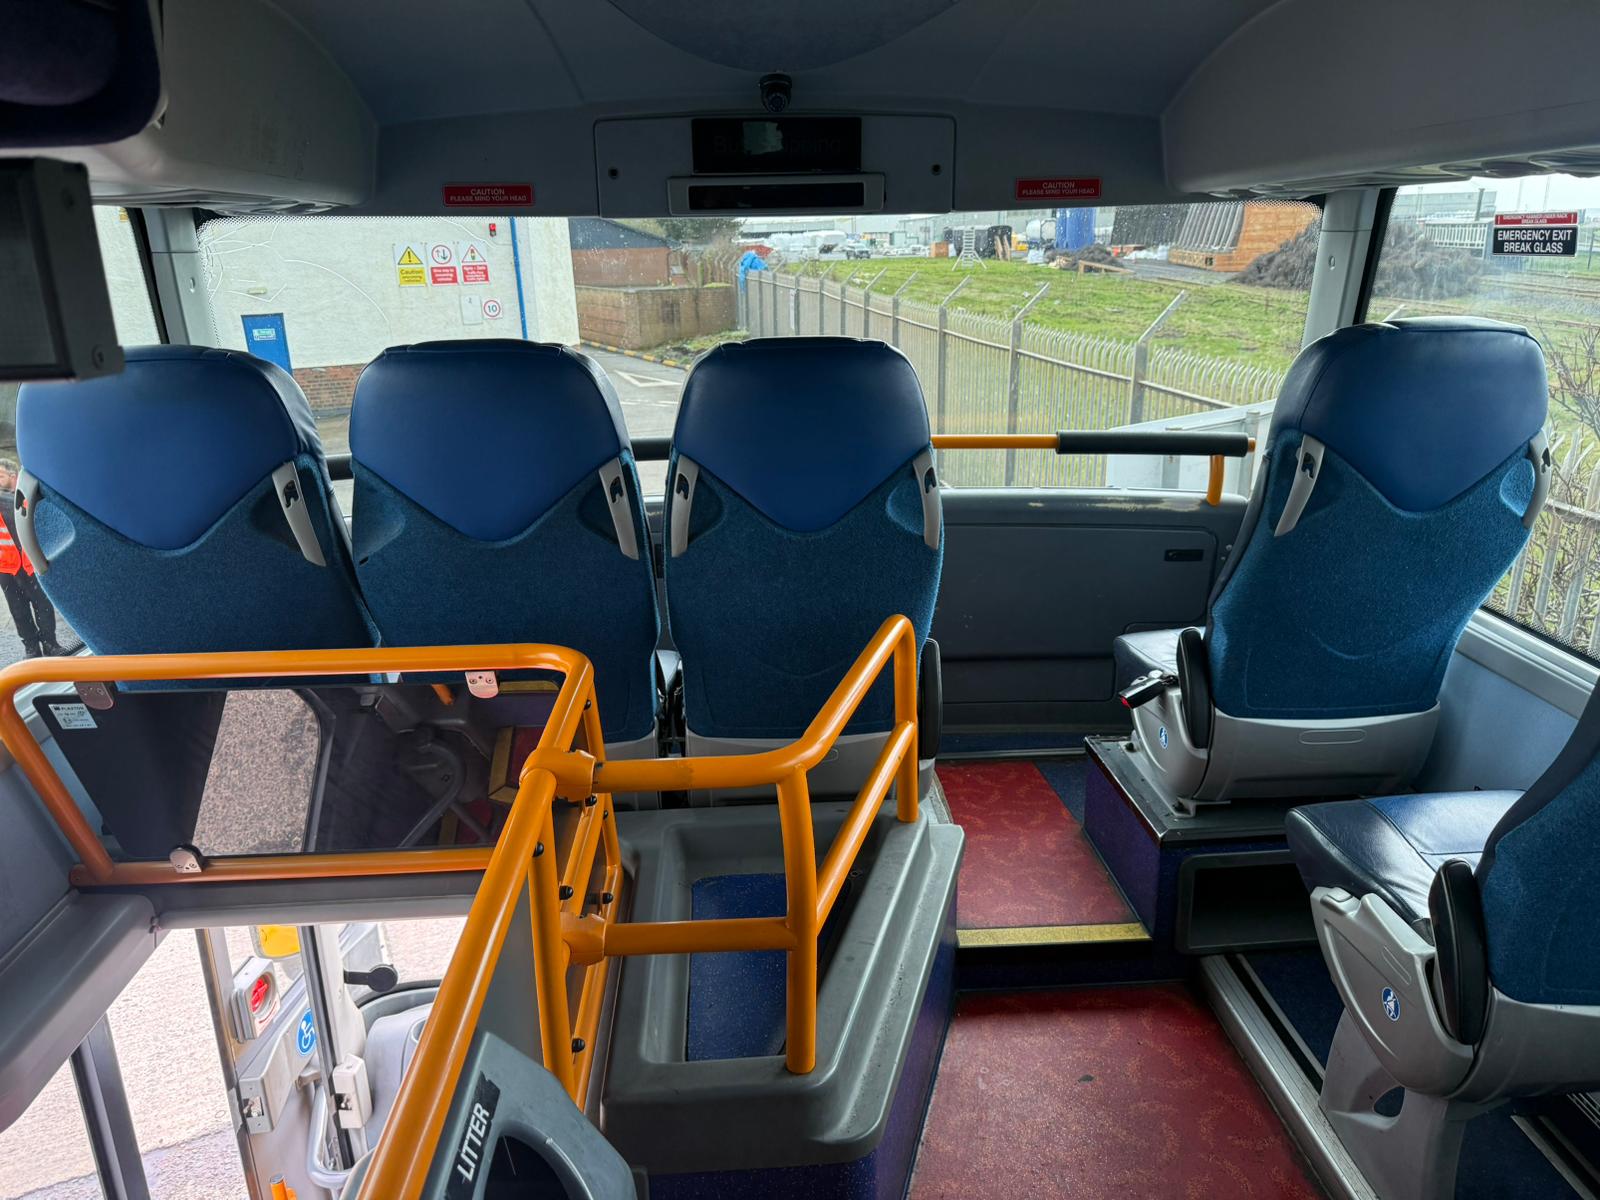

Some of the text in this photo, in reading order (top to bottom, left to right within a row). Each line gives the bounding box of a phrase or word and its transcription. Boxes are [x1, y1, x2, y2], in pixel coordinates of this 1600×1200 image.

[1042, 181, 1075, 189] CAUTION
[470, 188, 505, 196] CAUTION
[1497, 229, 1573, 241] EMERGENCY EXIT
[1503, 241, 1564, 253] BREAK GLASS
[487, 304, 498, 313] 10
[457, 1102, 490, 1182] LITTER
